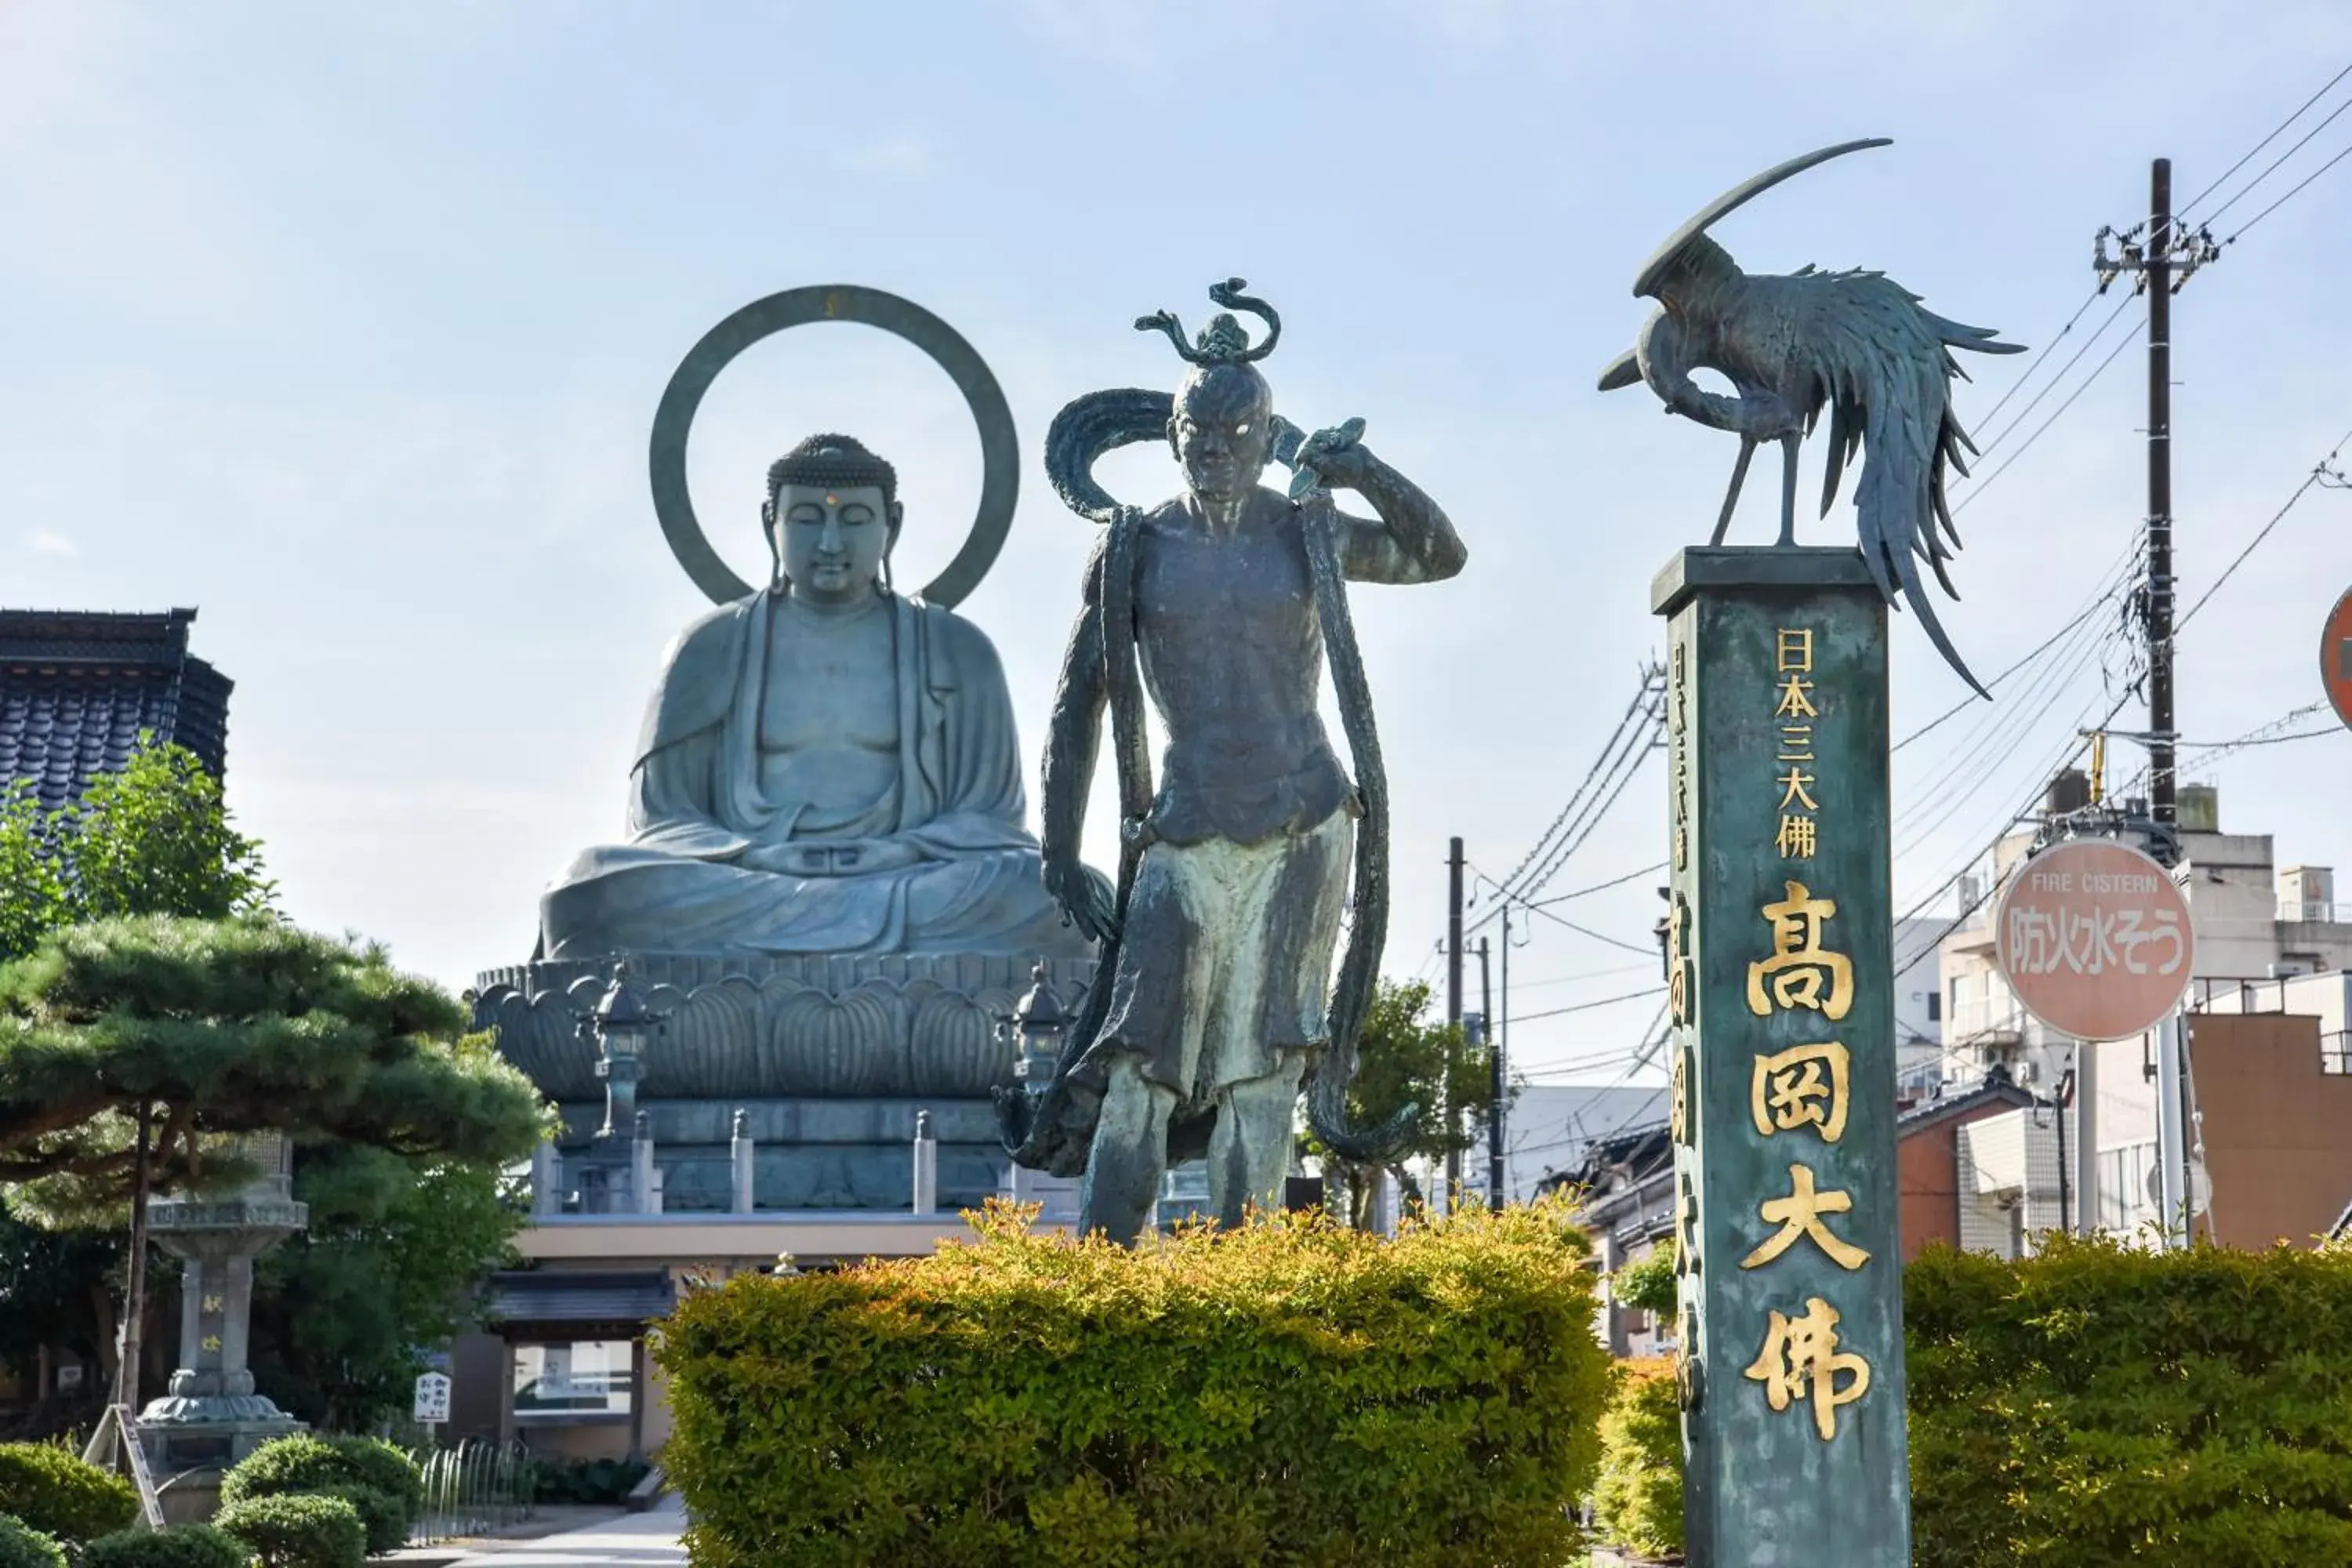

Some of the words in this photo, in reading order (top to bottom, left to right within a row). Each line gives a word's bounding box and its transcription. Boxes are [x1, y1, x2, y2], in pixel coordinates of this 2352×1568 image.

[1775, 628, 1819, 858] 日本三大佛
[2031, 873, 2073, 892] FIRE
[2082, 873, 2158, 893] CISTERN
[2009, 905, 2184, 975] 防火水そう
